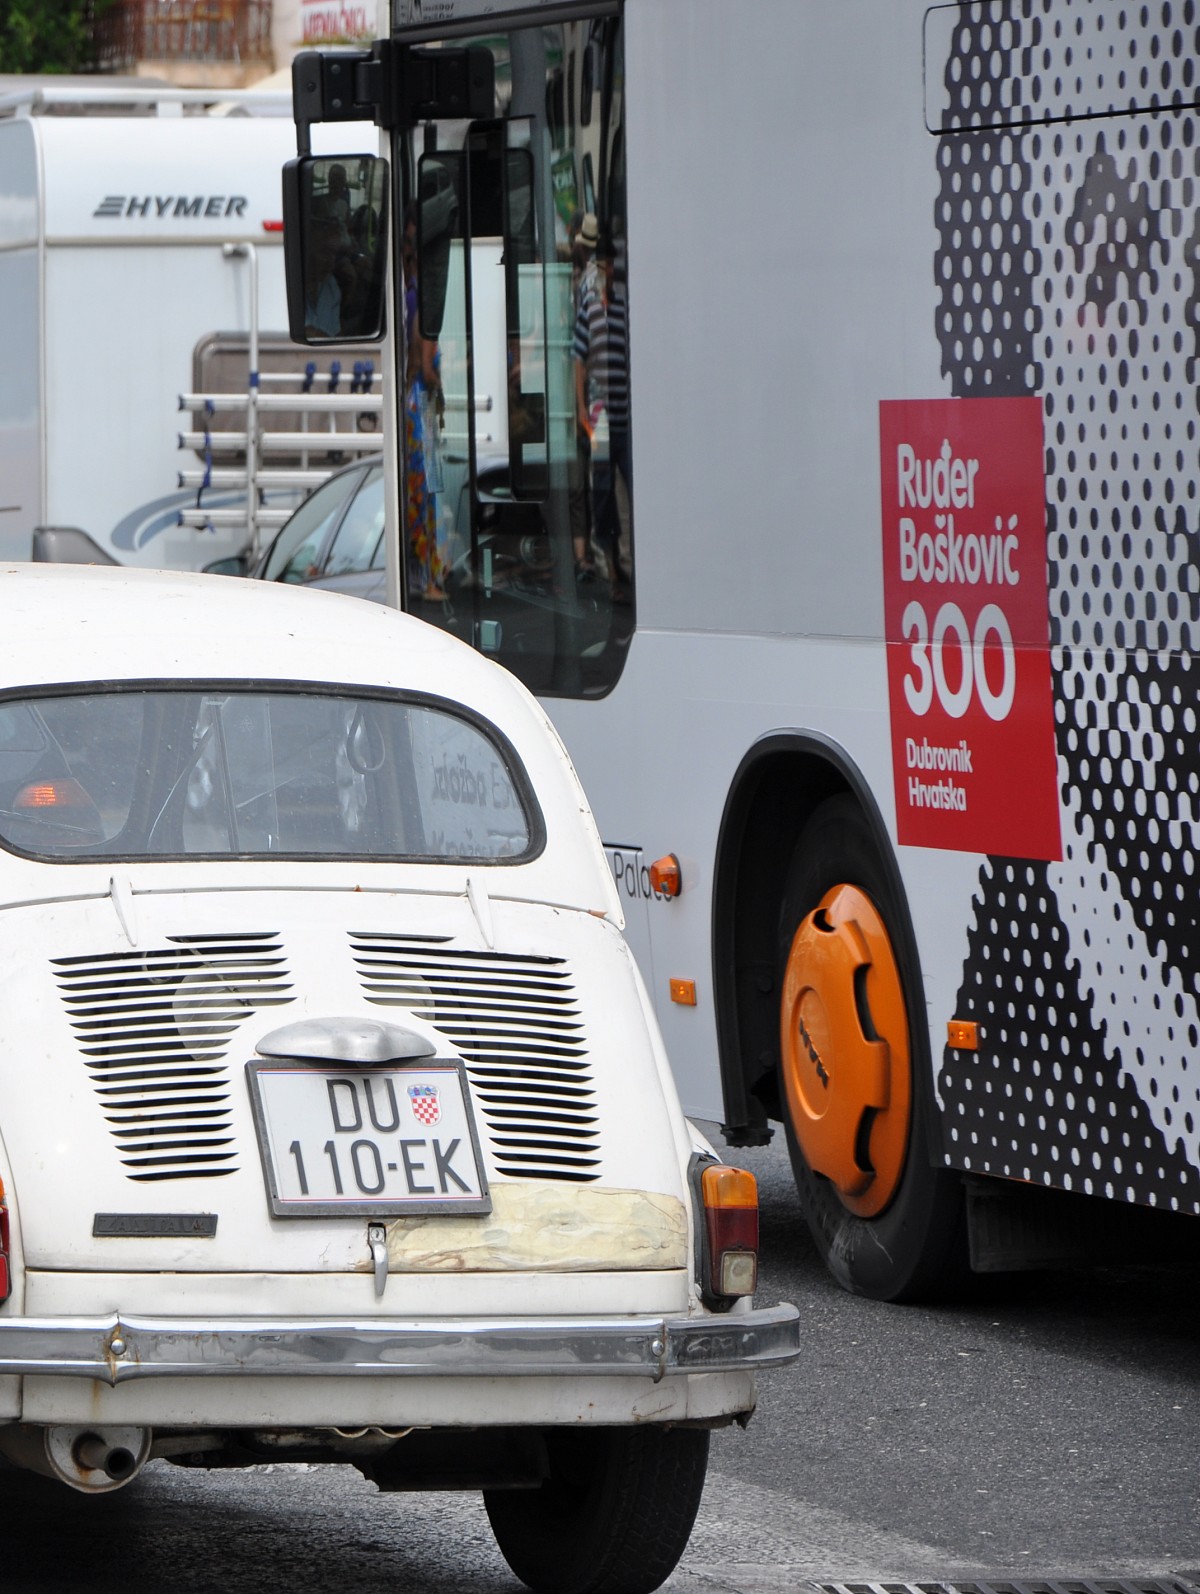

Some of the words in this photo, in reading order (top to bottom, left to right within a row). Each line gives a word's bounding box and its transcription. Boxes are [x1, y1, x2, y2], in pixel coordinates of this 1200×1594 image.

[125, 195, 249, 218] HYMER
[899, 512, 1021, 587] Bošković
[902, 600, 1017, 722] 300
[905, 737, 974, 775] Dubrovnik
[908, 777, 968, 812] Hrvatska
[613, 851, 673, 903] Pala
[325, 1078, 401, 1134] DU
[288, 1138, 473, 1196] 110-EK
